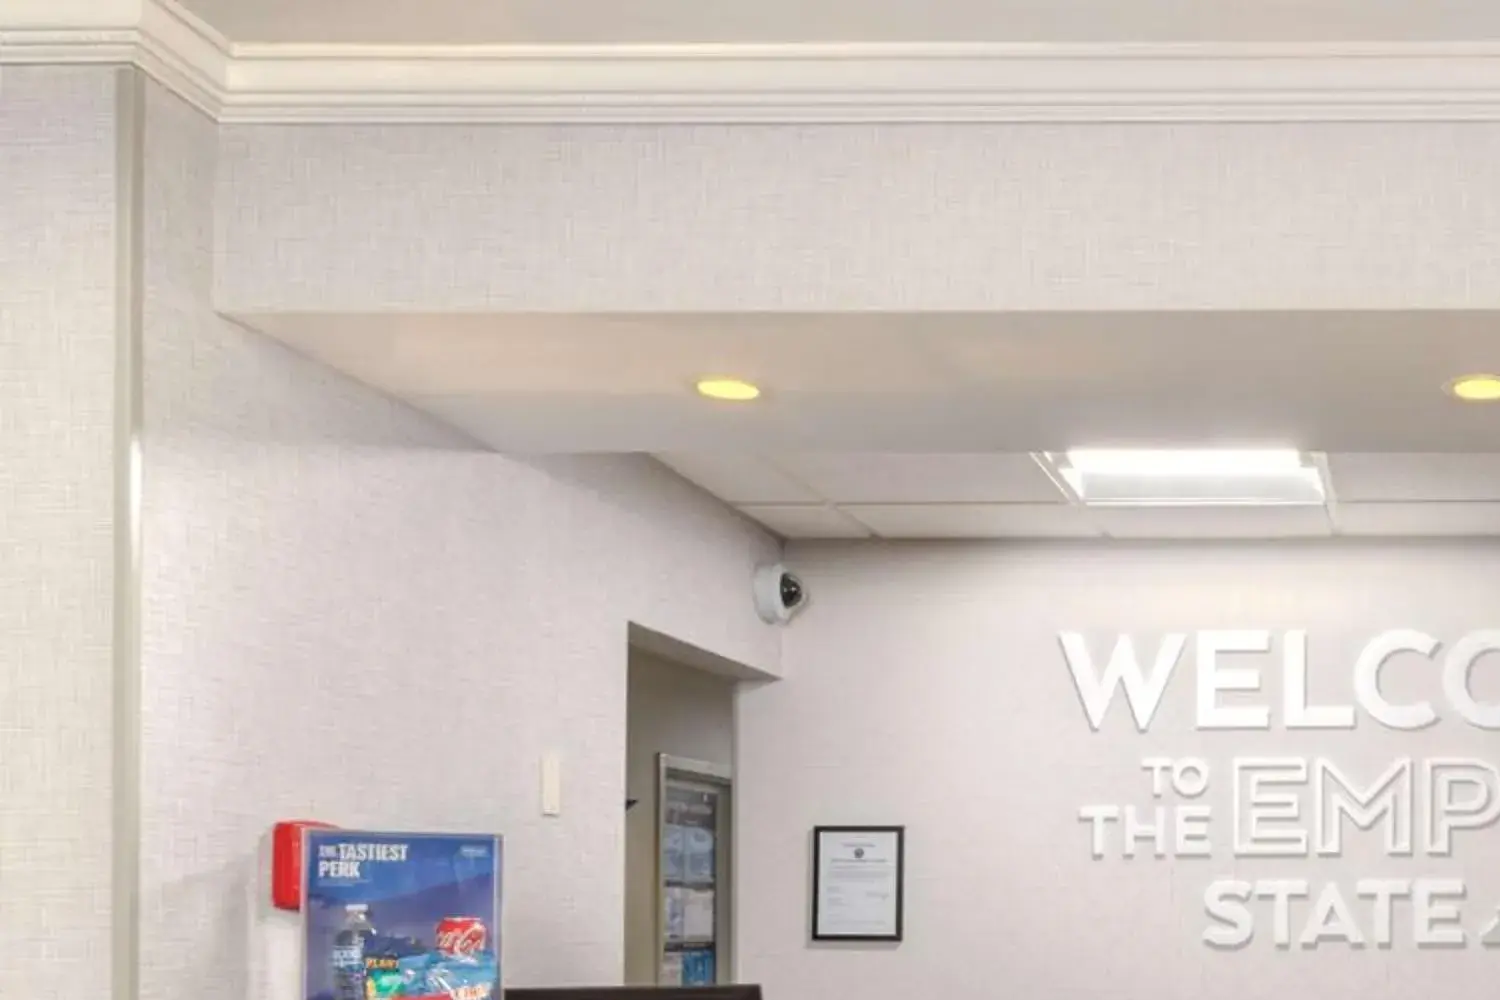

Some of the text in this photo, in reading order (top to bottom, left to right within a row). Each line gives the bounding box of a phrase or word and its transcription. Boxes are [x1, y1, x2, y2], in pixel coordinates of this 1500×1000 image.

[1141, 757, 1208, 798] TO
[338, 843, 408, 861] TASTIEST
[1078, 805, 1212, 859] THE
[319, 861, 360, 878] PERK
[1202, 878, 1468, 948] STATE
